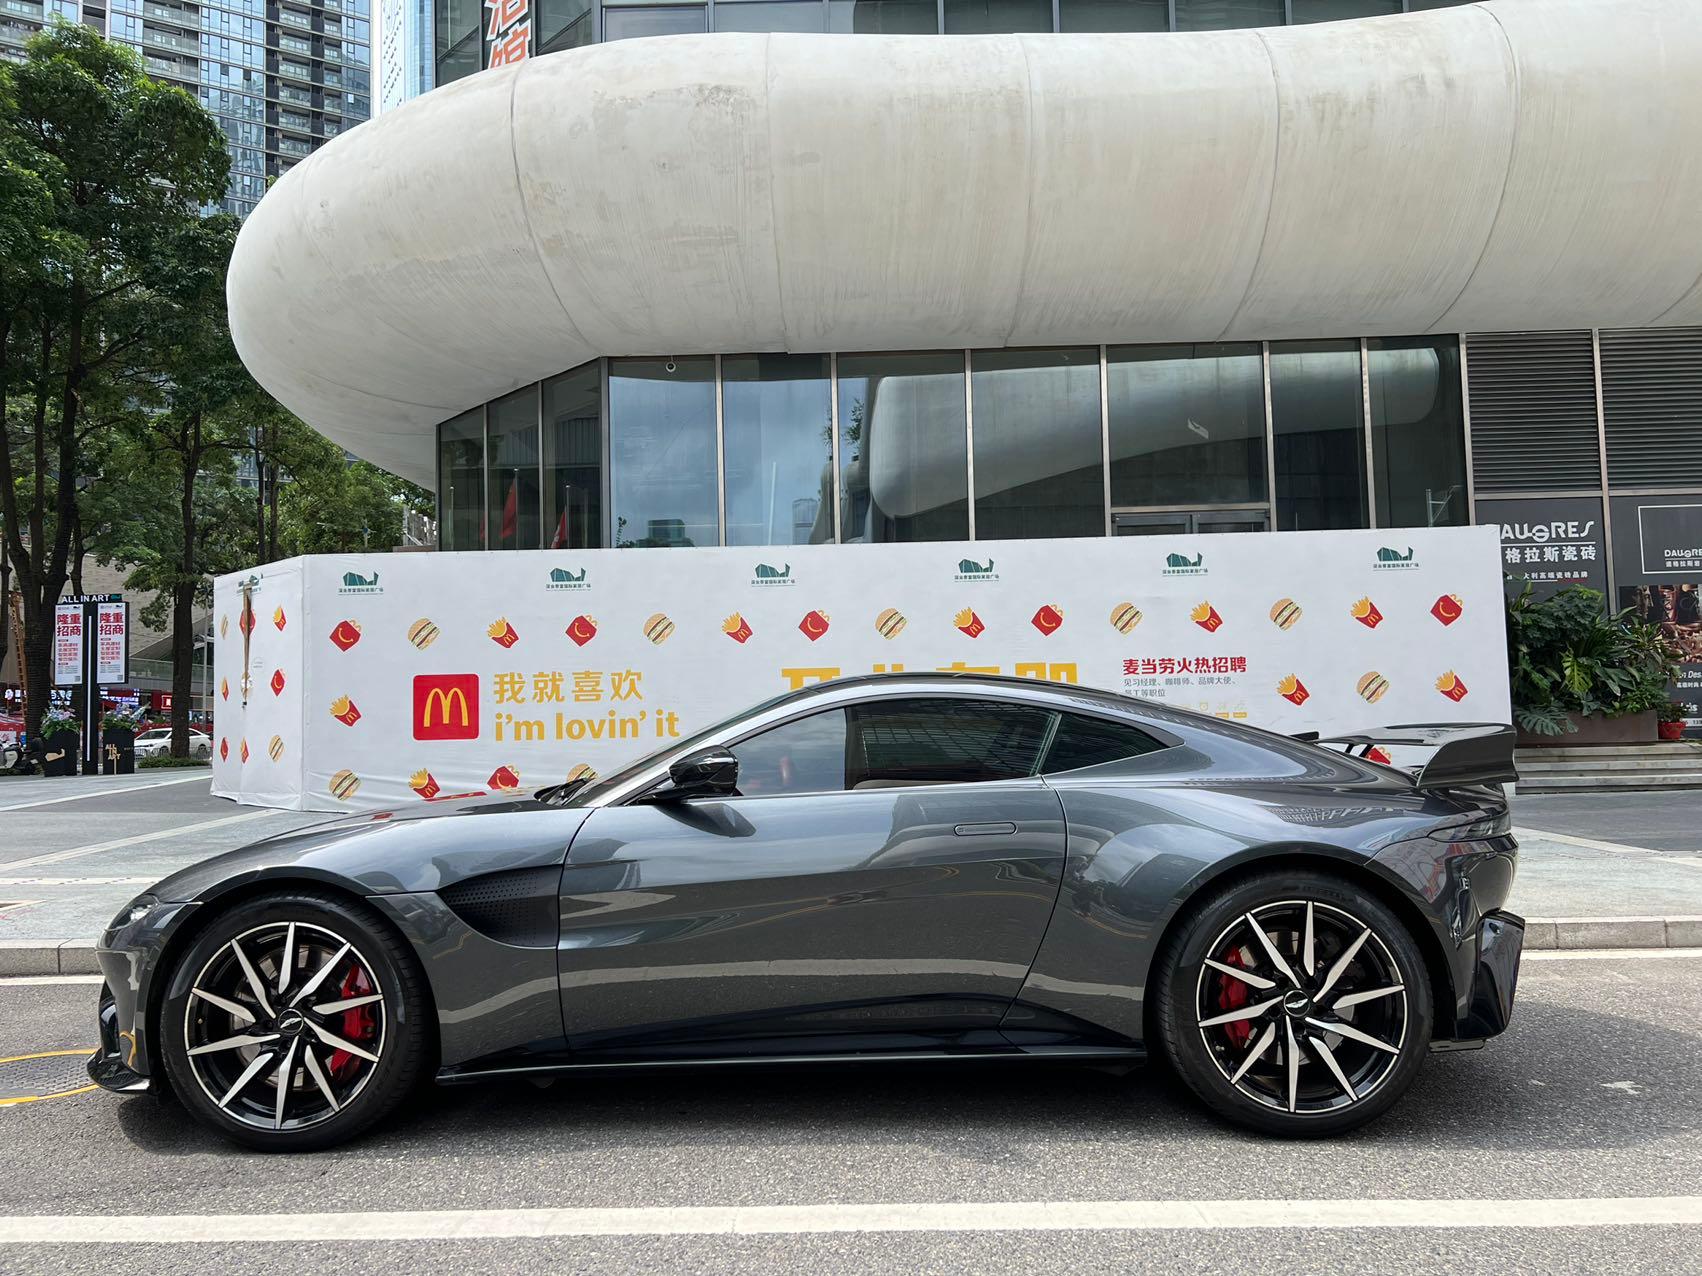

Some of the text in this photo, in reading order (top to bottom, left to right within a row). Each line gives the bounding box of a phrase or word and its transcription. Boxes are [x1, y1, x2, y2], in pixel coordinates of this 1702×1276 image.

[1500, 521, 1595, 542] AUGRES
[1505, 546, 1596, 563] 格拉斯瓷砖
[62, 595, 79, 603] ALL
[91, 594, 110, 602] ART
[57, 613, 81, 624] 隆重
[100, 612, 123, 623] 隆重
[57, 625, 81, 636] 招商
[100, 624, 123, 635] 招商
[1123, 656, 1247, 675] 麦当劳火热招聘
[494, 668, 642, 704] 我就喜欢
[495, 713, 545, 741] i'm
[656, 709, 680, 737] it
